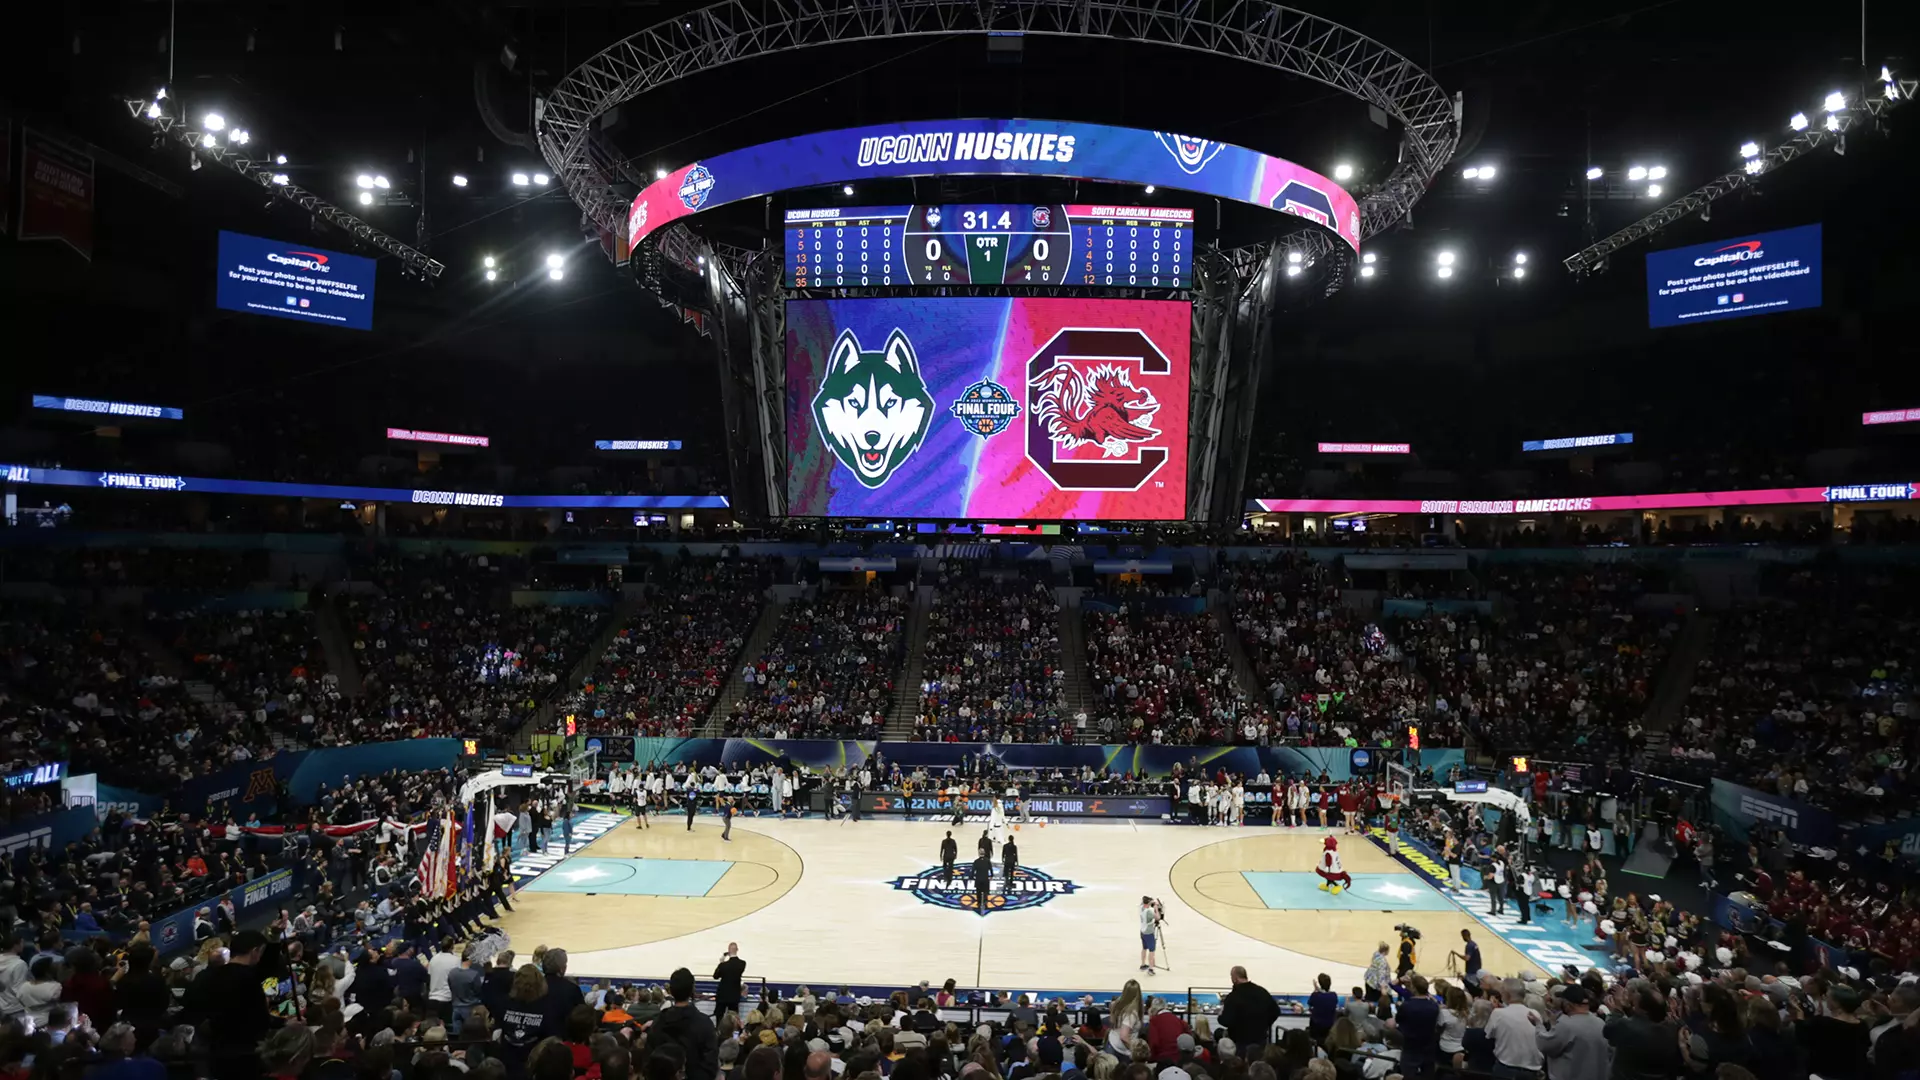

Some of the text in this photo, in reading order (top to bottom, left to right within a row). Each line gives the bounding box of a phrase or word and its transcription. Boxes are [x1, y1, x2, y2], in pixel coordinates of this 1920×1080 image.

[858, 132, 1075, 166] UCONN HUSKIES
[787, 209, 840, 219] UCONN HUSKIES
[1091, 207, 1192, 218] SOUTH CAROLINA GAMECOCKS
[963, 211, 1011, 229] 31.4
[798, 227, 890, 239] 3 0 0 0 0
[1087, 227, 1181, 239] 1 0 0 0 0
[798, 239, 890, 251] 5 0 0 0 0
[976, 237, 998, 248] QTR
[1086, 239, 1180, 251] 3 0 0 0 0
[926, 239, 941, 261] 0
[1033, 239, 1049, 261] 0
[796, 252, 890, 263] 13 0 0 0 0
[984, 251, 991, 262] 1
[1086, 251, 1180, 262] 4 0 0 0 0
[796, 264, 890, 276] 20 0 0 0 0
[1086, 262, 1180, 274] 5 0 0 0 0
[238, 265, 255, 273] Post
[257, 268, 273, 278] your
[274, 271, 295, 281] photo
[296, 275, 316, 285] using
[926, 272, 950, 281] 4 0
[1025, 272, 1049, 281] 4 0
[1084, 275, 1179, 287] 12 0 0 0 0
[1667, 278, 1684, 287] Post
[1685, 277, 1702, 286] your
[1703, 272, 1725, 283] photo
[1726, 269, 1748, 278] using
[229, 270, 240, 279] for
[242, 274, 259, 283] your
[260, 275, 285, 286] chance
[286, 280, 294, 288] to
[295, 282, 304, 290] be
[315, 286, 327, 294] the
[328, 288, 365, 300] videoboard
[796, 276, 890, 287] 35 0 0 0 0
[1659, 287, 1670, 296] for
[1671, 286, 1687, 296] your
[1689, 281, 1715, 291] chance
[1726, 278, 1736, 286] be
[1749, 274, 1762, 282] the
[1763, 267, 1810, 280] videoboard
[64, 399, 161, 417] UCONN HUSKIES
[957, 403, 1015, 414] FINAL FOUR
[638, 440, 668, 450] HUSKIES
[1575, 435, 1616, 447] HUSKIES
[8, 467, 30, 481] ALL
[108, 475, 142, 487] FINAL
[144, 477, 177, 489] FOUR
[412, 490, 504, 506] UCONN HUSKIES
[1831, 486, 1906, 499] FINAL FOUR
[1420, 498, 1592, 513] SOUTH CAROLINA GAMECOCKS
[34, 763, 60, 784] ALL
[231, 787, 239, 796] BY
[1056, 801, 1083, 812] FOUR
[1741, 794, 1799, 829] ESPN
[901, 878, 976, 890] FINAL
[244, 875, 292, 908] FINAL FOUR
